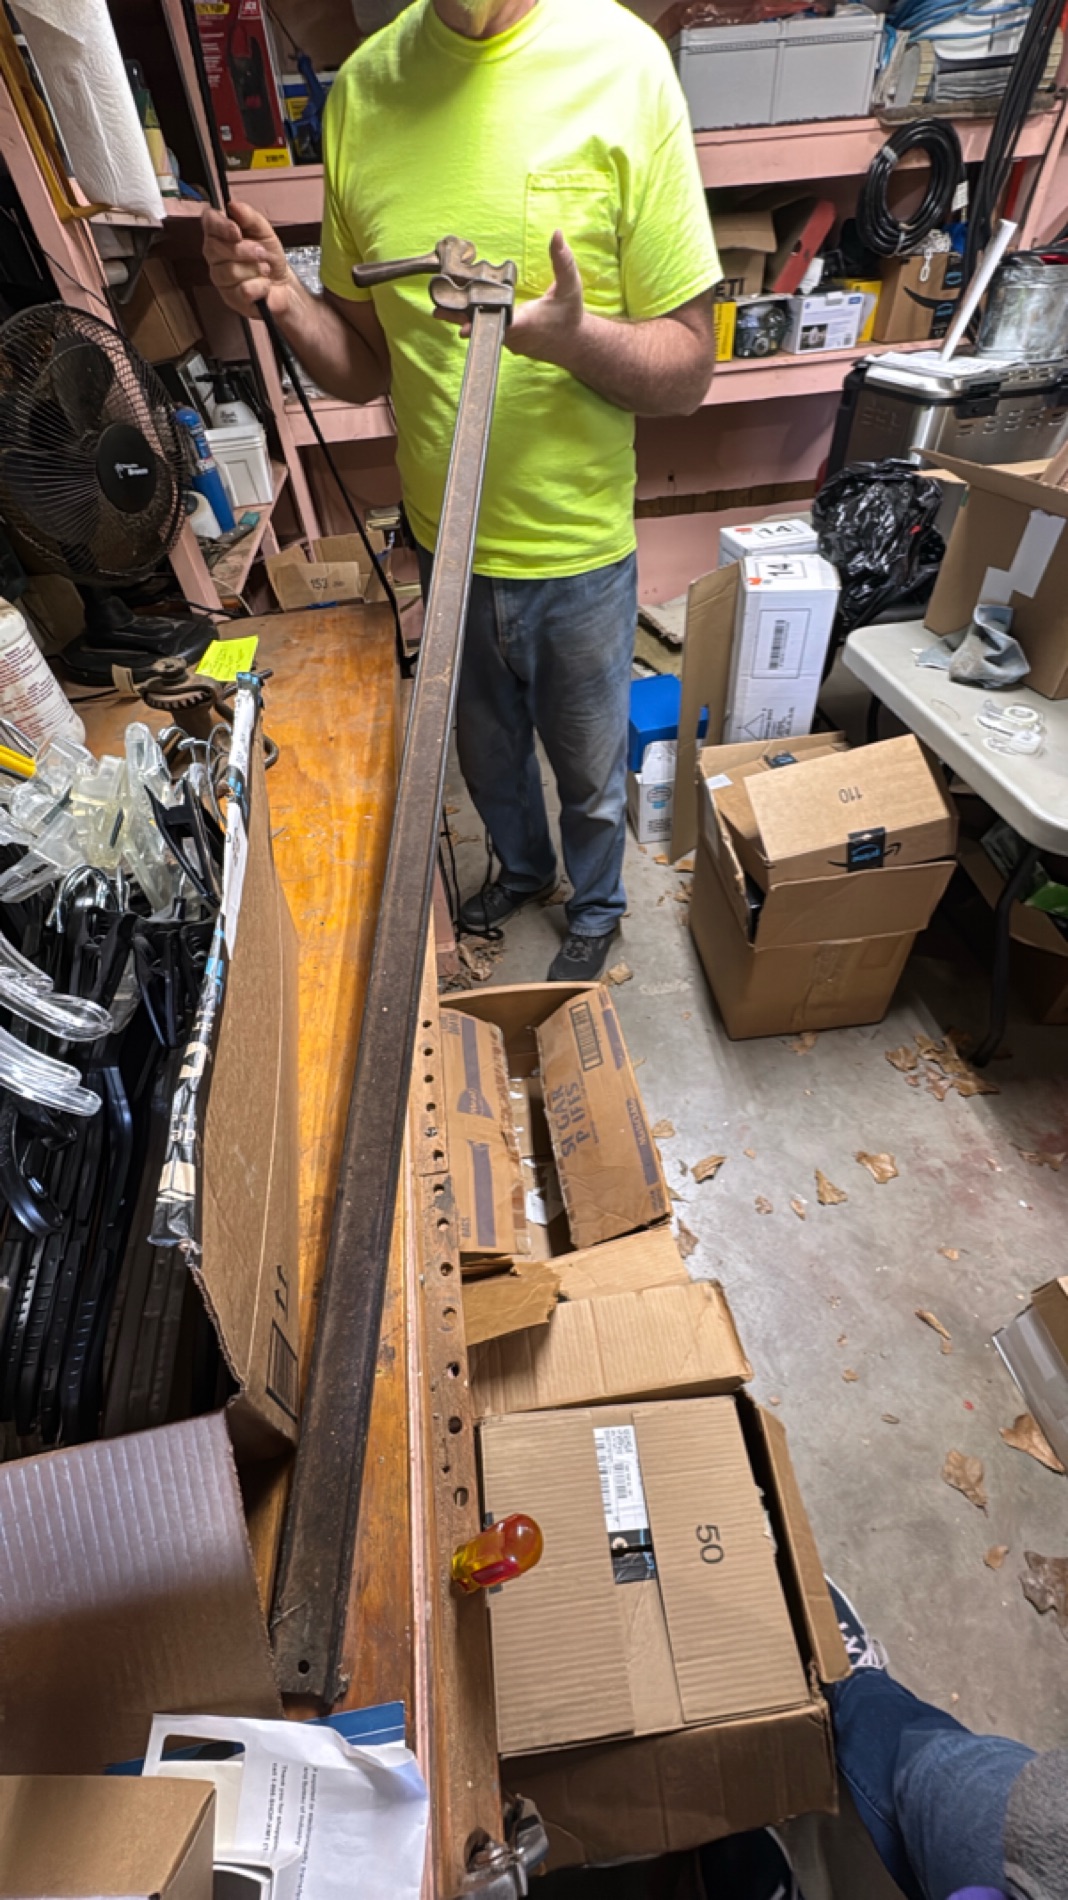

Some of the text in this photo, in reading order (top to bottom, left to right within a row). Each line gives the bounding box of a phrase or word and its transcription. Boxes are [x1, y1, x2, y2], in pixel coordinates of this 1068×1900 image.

[714, 277, 745, 298] ETI
[758, 523, 794, 536] 14
[766, 562, 795, 577] 14
[838, 786, 863, 804] 110
[695, 1524, 725, 1564] 50
